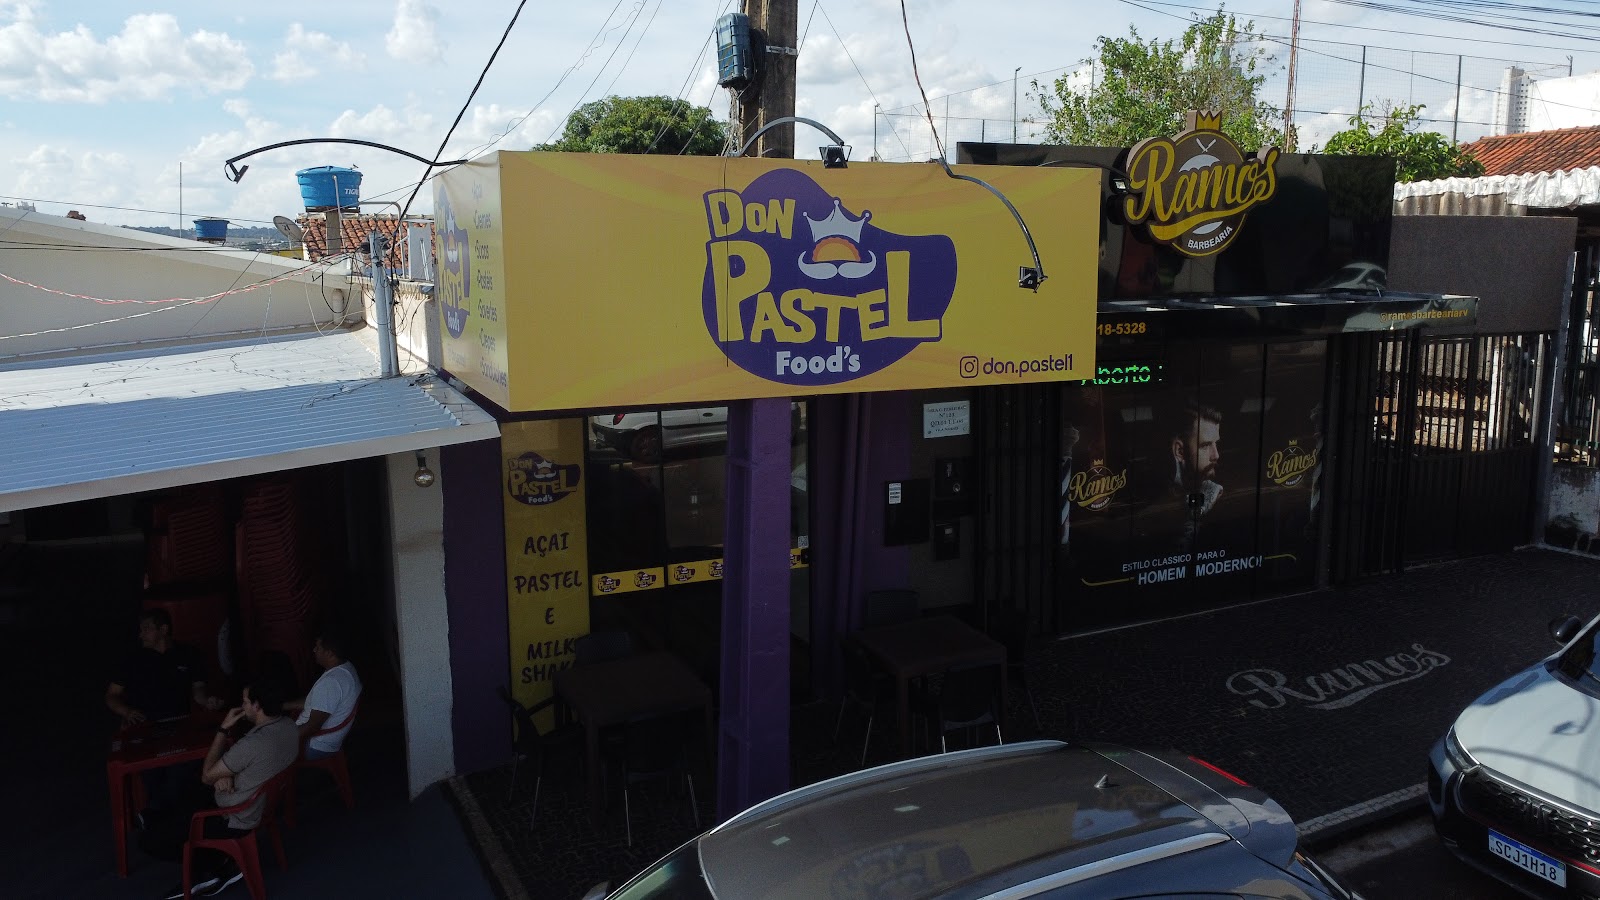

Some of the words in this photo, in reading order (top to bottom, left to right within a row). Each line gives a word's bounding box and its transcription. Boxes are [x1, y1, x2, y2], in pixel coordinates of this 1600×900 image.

[1127, 141, 1279, 240] Ramos
[707, 190, 795, 239] DON
[1187, 226, 1233, 249] BARBEARIA
[436, 234, 470, 311] PASTEL
[711, 240, 940, 343] PASTEL
[776, 345, 860, 376] Food's
[982, 353, 1073, 378] don.pastel1
[1081, 365, 1151, 385] berto
[508, 458, 532, 470] DON
[1268, 449, 1316, 484] Ramos
[509, 469, 578, 496] PASTEL
[1068, 469, 1127, 508] Ramos
[528, 494, 553, 504] Food's
[524, 532, 569, 558] AÇAI
[1122, 559, 1150, 572] ESTILO
[1151, 553, 1192, 568] CLASSICO
[1197, 550, 1218, 561] PARA
[1219, 549, 1226, 558] O
[513, 570, 583, 594] PASTEL
[1138, 566, 1186, 585] HOMEM
[544, 607, 555, 624] E
[527, 638, 576, 660] MILK
[1226, 643, 1451, 710] Ramos
[1496, 841, 1557, 880] SCJ1H18
